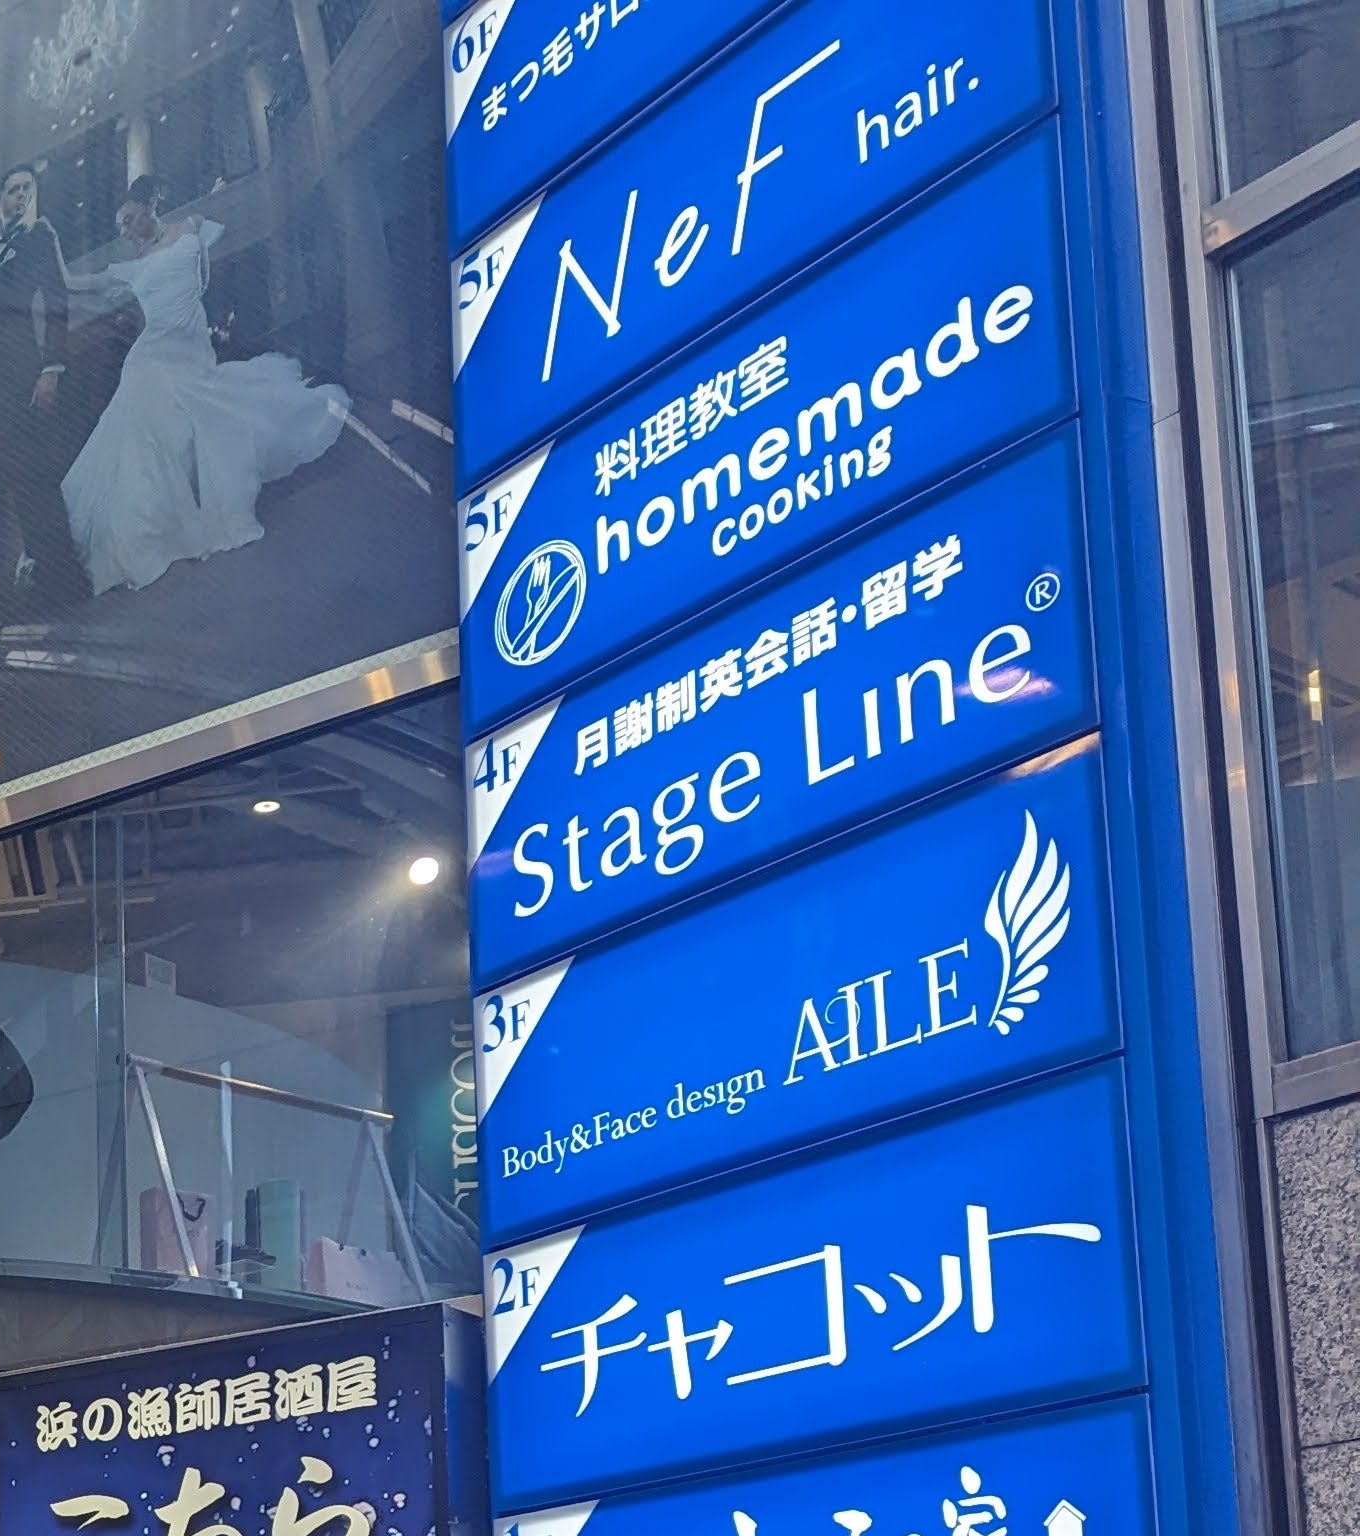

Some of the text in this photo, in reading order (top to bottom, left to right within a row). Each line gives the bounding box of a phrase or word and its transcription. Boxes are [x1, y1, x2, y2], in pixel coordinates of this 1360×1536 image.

[451, 10, 499, 74] 6F
[541, 40, 979, 381] NeF hair.
[458, 246, 505, 311] 5F
[595, 336, 789, 497] 料理教室
[596, 285, 1033, 574] homemade
[464, 490, 512, 552] 5F
[712, 426, 892, 555] cooking
[574, 534, 964, 776] 月謝制英会話・留学
[473, 741, 521, 794] 4F
[513, 747, 762, 918] Stage
[482, 994, 530, 1053] 3F
[782, 937, 977, 1086] AILE
[502, 1068, 766, 1178] Body&Face design
[490, 1258, 541, 1316] 2F
[541, 1204, 1101, 1418] チャコット
[36, 1356, 377, 1452] 浜の漁師居酒屋
